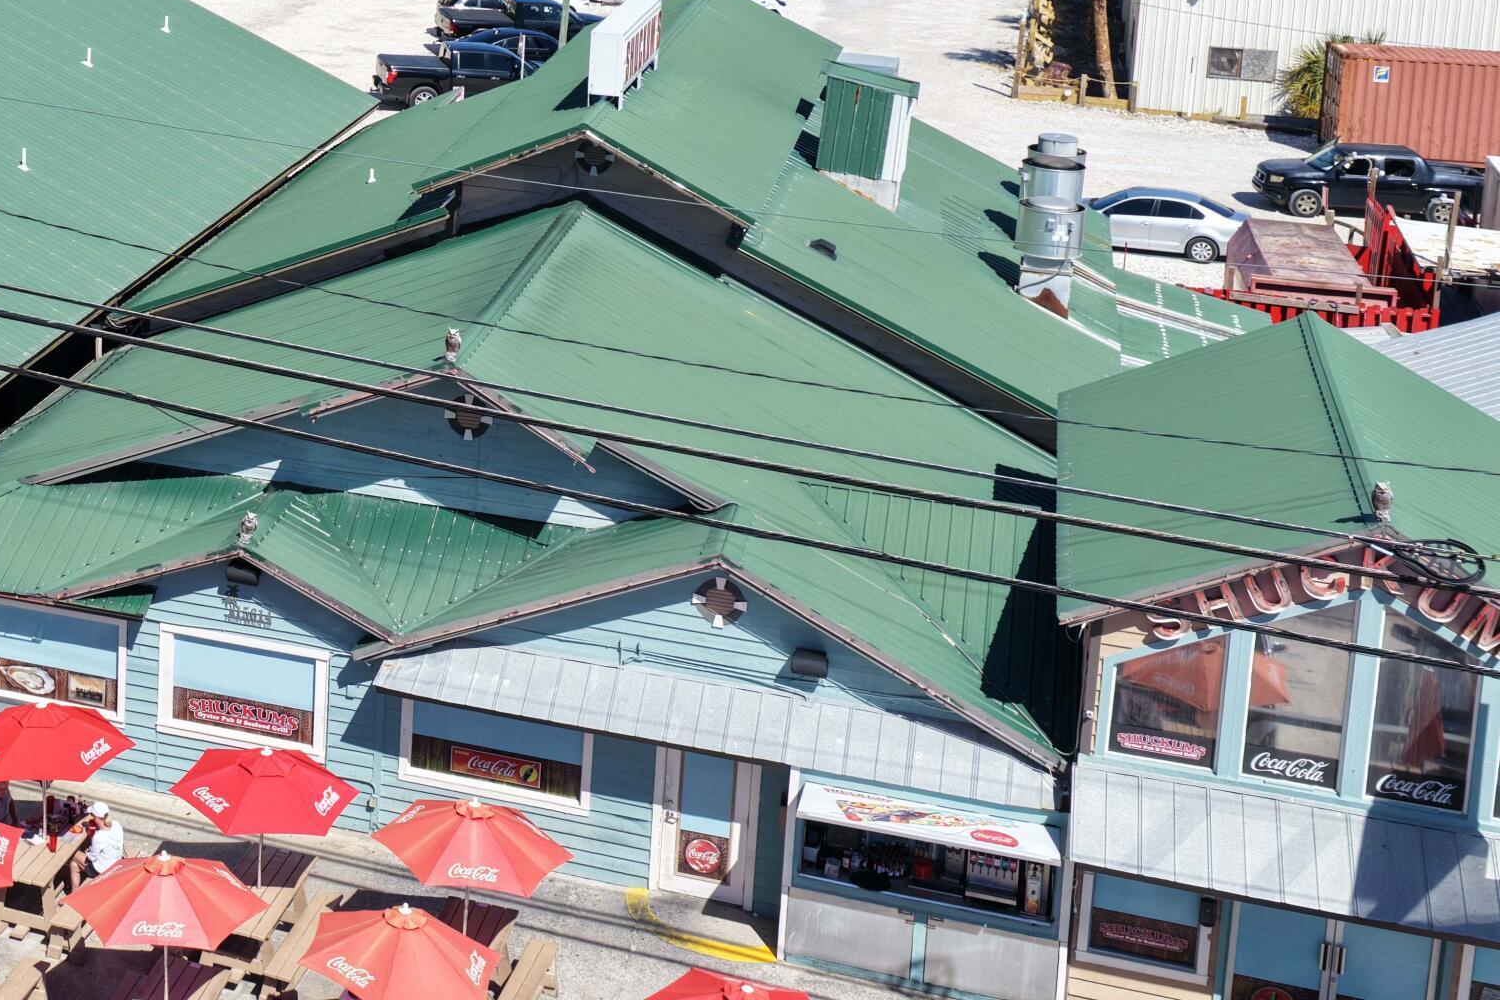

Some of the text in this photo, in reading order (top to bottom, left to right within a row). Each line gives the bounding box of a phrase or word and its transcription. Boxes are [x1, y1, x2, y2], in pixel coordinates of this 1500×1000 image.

[188, 698, 299, 731] SHUCKUMS
[197, 711, 221, 721] Oyster
[221, 715, 235, 724] Pub
[243, 719, 271, 730] Seafood
[271, 724, 289, 733] Grill
[1117, 732, 1206, 756] SHUCKUMS
[1099, 922, 1189, 949] SHUCKUMS
